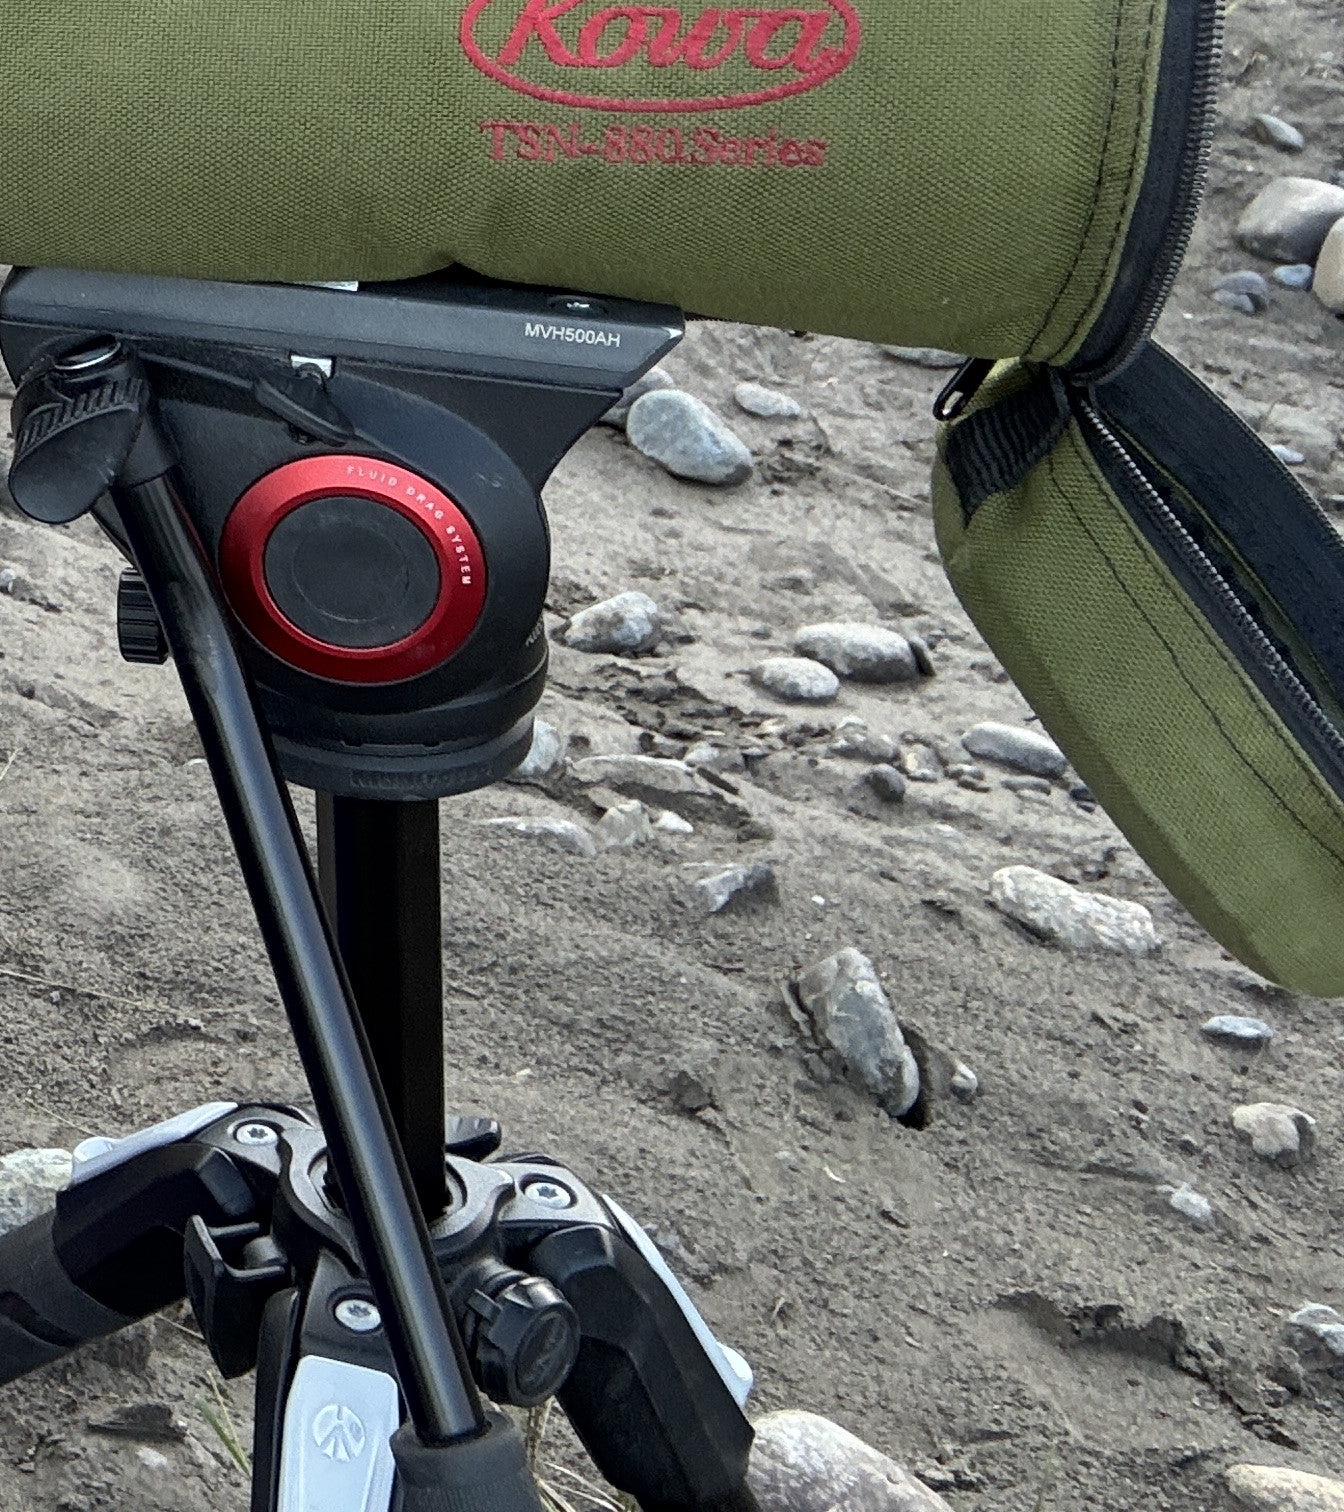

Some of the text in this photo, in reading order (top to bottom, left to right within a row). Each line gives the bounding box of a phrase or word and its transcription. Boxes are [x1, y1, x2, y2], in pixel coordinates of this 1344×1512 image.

[694, 125, 828, 166] Series
[524, 322, 621, 348] MVH500AH
[345, 464, 472, 586] FLUID DRAG SYSTEM
